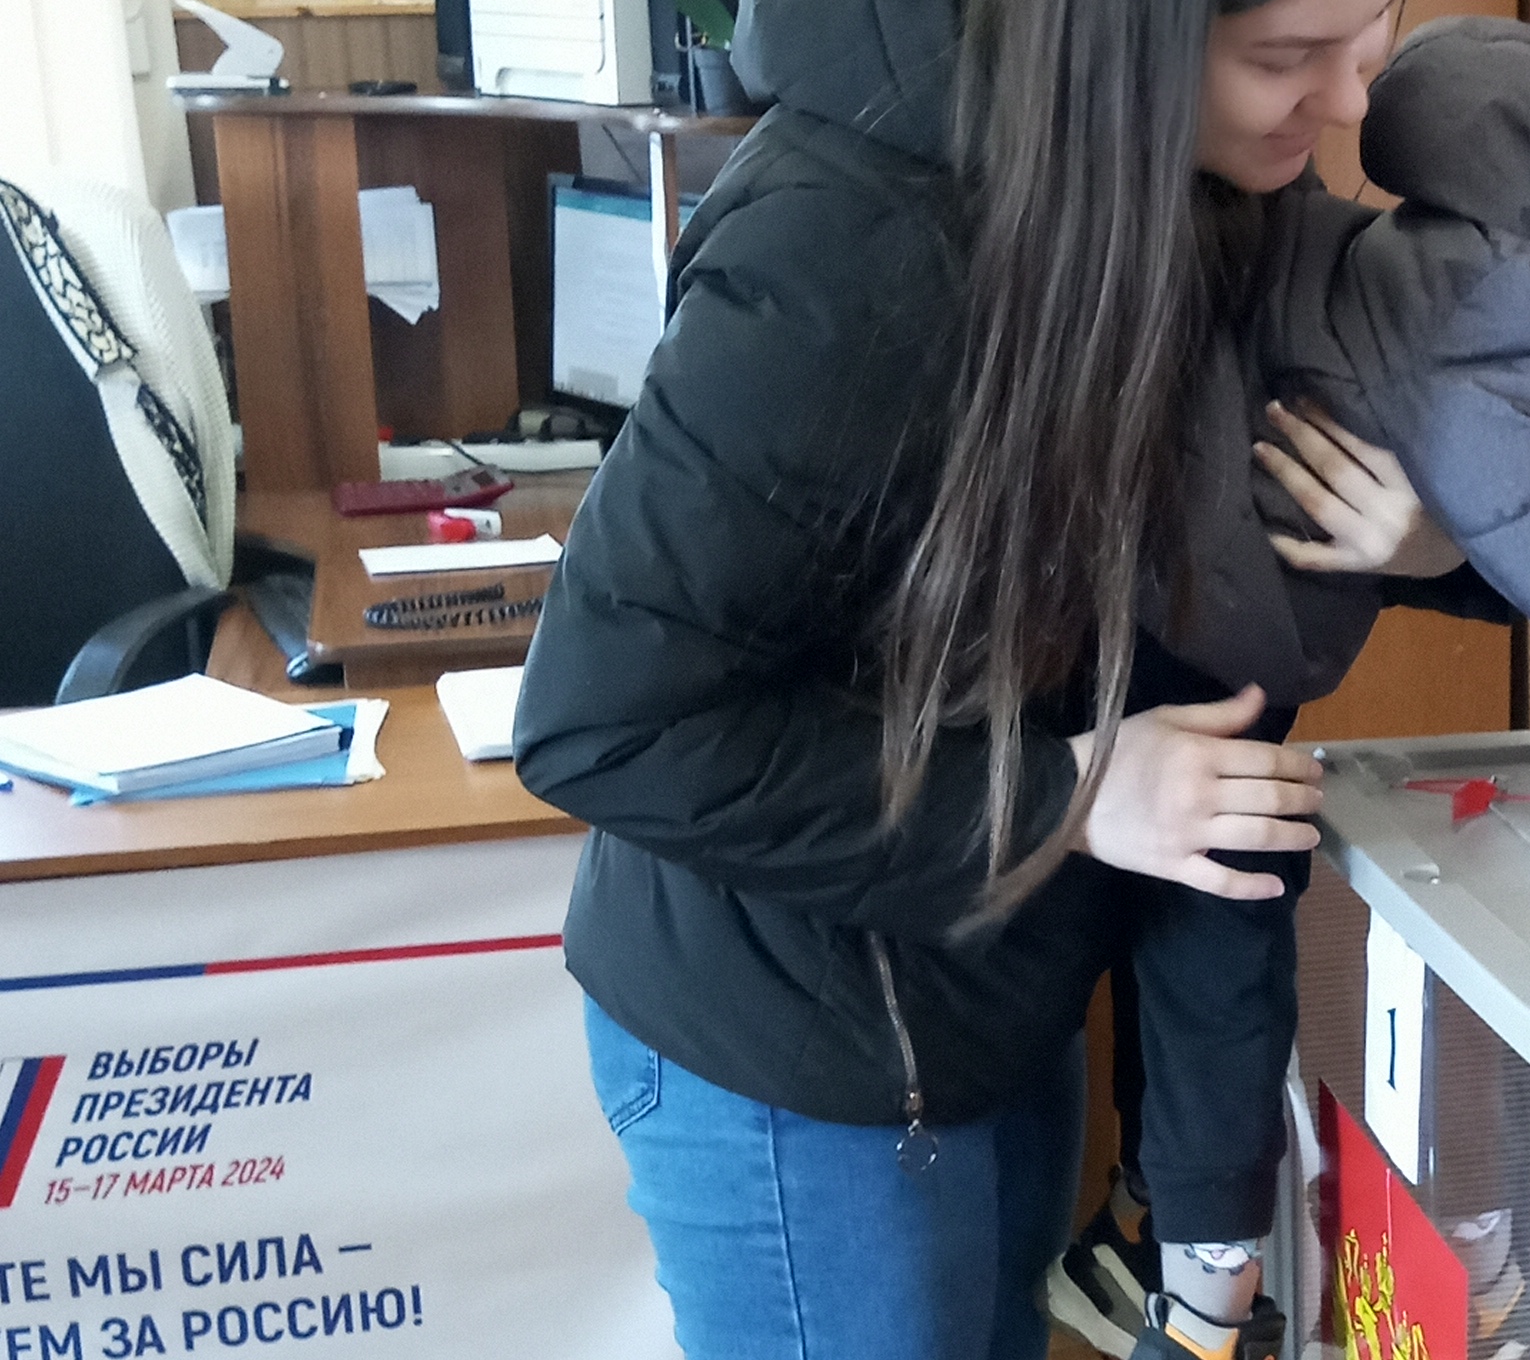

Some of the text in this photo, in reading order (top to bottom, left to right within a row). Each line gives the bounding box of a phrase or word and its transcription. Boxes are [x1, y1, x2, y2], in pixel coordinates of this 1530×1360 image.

[87, 1038, 259, 1081] ВЫБОРЫ
[71, 1072, 313, 1124] ПРЕЗИДЕНТА
[55, 1123, 212, 1168] РОССИИ
[123, 1163, 216, 1197] МАРТА
[221, 1155, 285, 1187] 2024
[66, 1249, 162, 1299] МЫ
[180, 1233, 323, 1287] СИЛА
[100, 1314, 167, 1360] ЗА
[181, 1284, 424, 1352] РОССИЮ!
